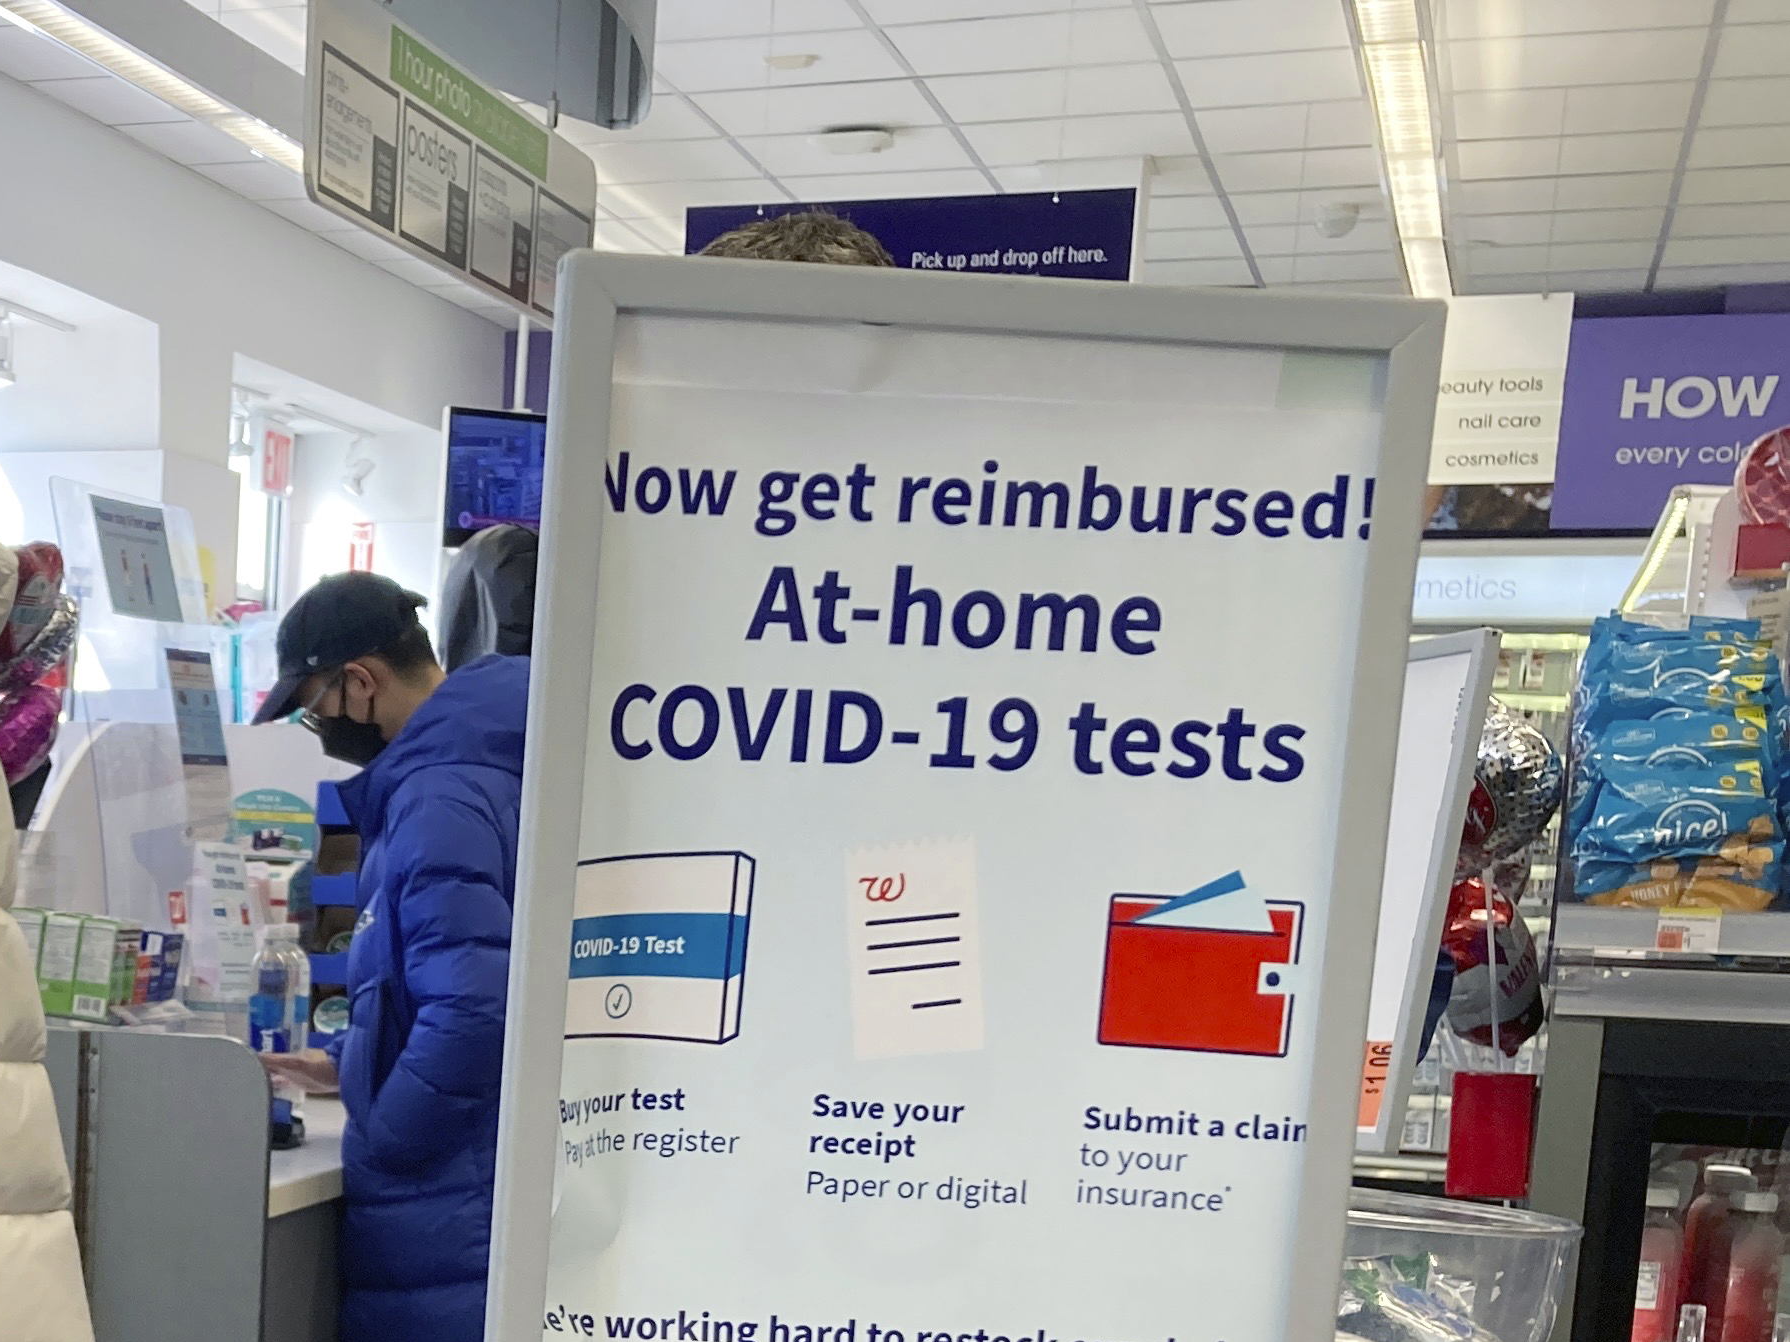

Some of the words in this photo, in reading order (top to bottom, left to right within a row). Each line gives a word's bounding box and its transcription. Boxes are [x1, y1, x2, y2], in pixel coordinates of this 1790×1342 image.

[408, 46, 435, 90] hour
[435, 71, 472, 118] photo
[408, 124, 459, 182] posters
[912, 251, 943, 269] Pick
[948, 254, 967, 271] up
[970, 250, 999, 268] and
[1003, 248, 1038, 269] drop
[1042, 247, 1066, 265] off
[1068, 246, 1108, 264] here.
[1439, 377, 1494, 396] eauty
[1499, 375, 1544, 393] tools
[1618, 375, 1780, 420] HOW
[1458, 412, 1493, 430] nail
[1497, 414, 1542, 430] care
[264, 430, 292, 492] EXIT
[1445, 449, 1539, 468] cosmetics
[1615, 445, 1690, 469] every
[753, 463, 876, 539] get
[896, 460, 1377, 542] reimbursed!
[744, 565, 1164, 657] At-home
[610, 683, 1040, 774] COVID-19
[1068, 701, 1307, 784] tests
[573, 935, 640, 959] COVID-19
[644, 935, 686, 955] Test
[560, 1098, 583, 1126] Buy
[583, 1091, 626, 1125] your
[631, 1087, 686, 1112] test
[811, 1093, 888, 1121] Save
[893, 1098, 965, 1130] your
[1083, 1105, 1200, 1136] Submit
[1207, 1118, 1225, 1138] a
[565, 1139, 583, 1169] Pay
[584, 1133, 596, 1158] at
[595, 1129, 626, 1152] the
[632, 1127, 741, 1158] register
[809, 1130, 916, 1163] receipt
[1079, 1142, 1110, 1167] to
[1116, 1149, 1188, 1176] your
[807, 1170, 891, 1202] Paper
[897, 1178, 930, 1200] or
[934, 1174, 1029, 1210] digital
[543, 1305, 595, 1337] e're
